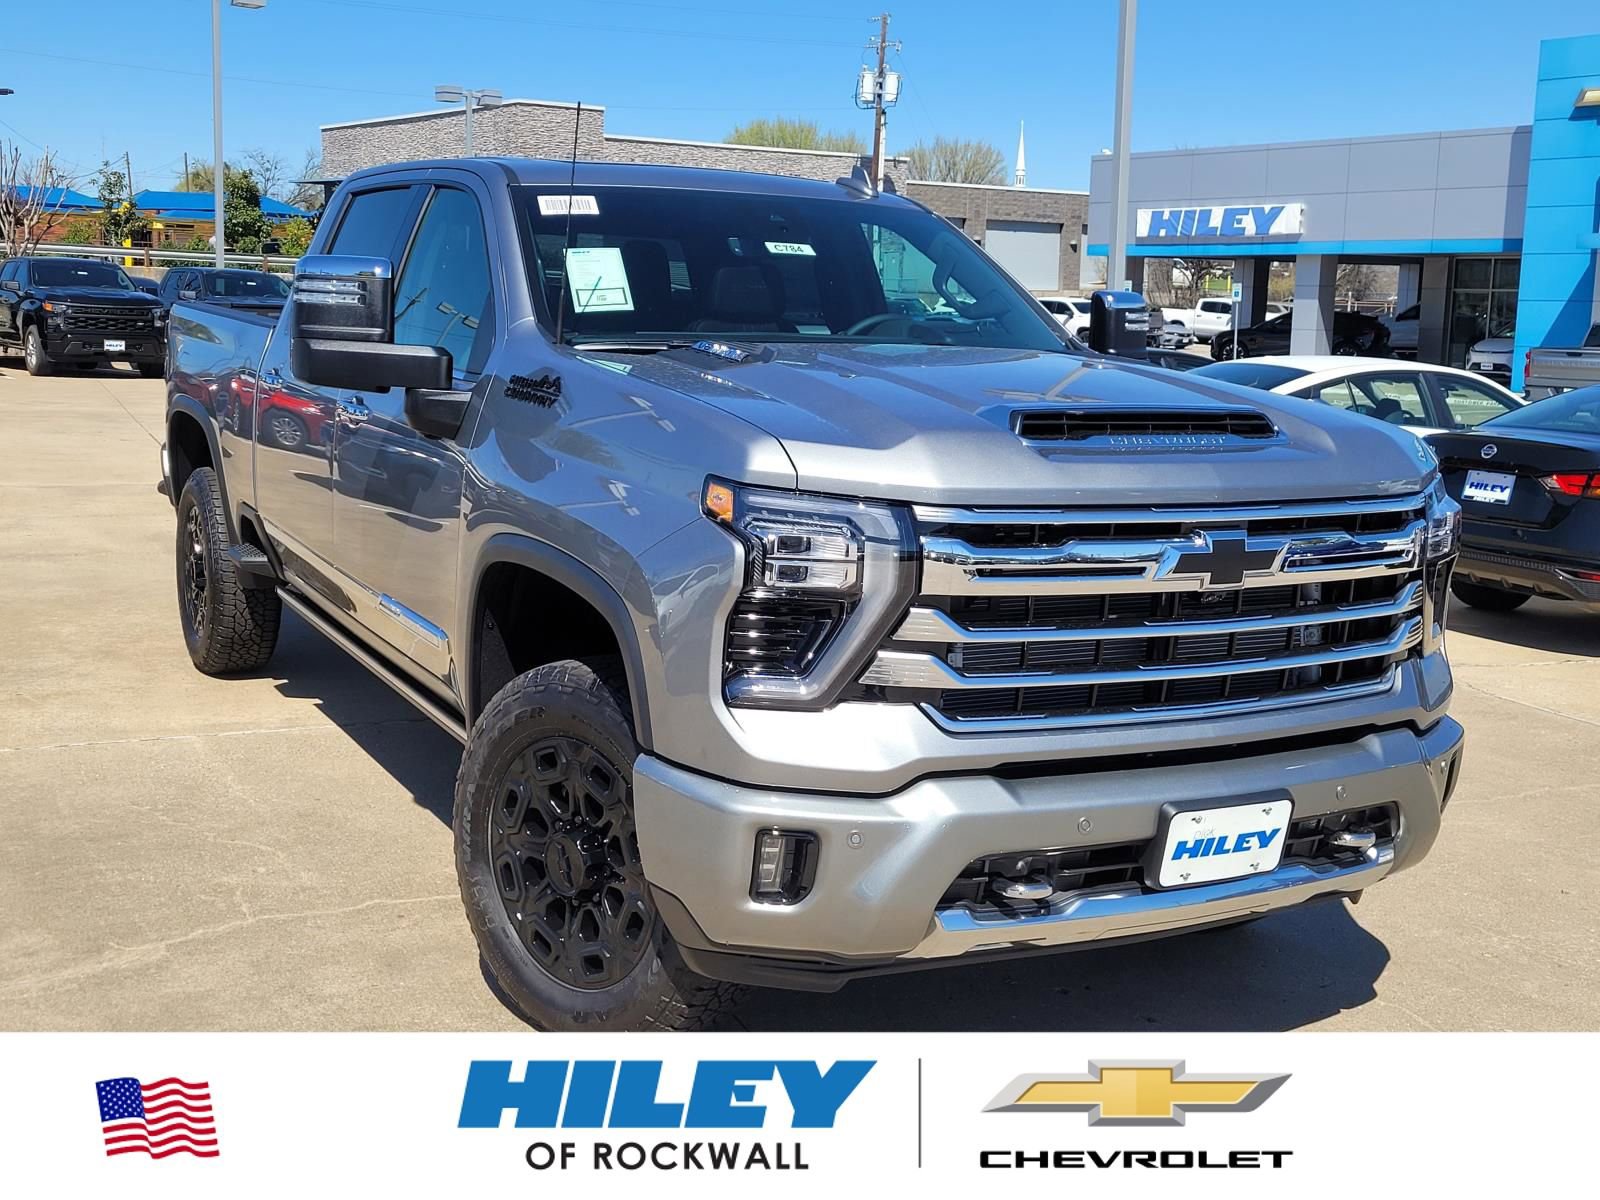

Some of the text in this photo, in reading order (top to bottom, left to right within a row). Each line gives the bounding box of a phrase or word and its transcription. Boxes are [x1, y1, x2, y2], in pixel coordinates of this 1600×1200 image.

[1148, 206, 1285, 236] HILEY
[774, 244, 804, 253] C784
[1468, 481, 1510, 493] HILEY
[1171, 828, 1281, 861] HILEY
